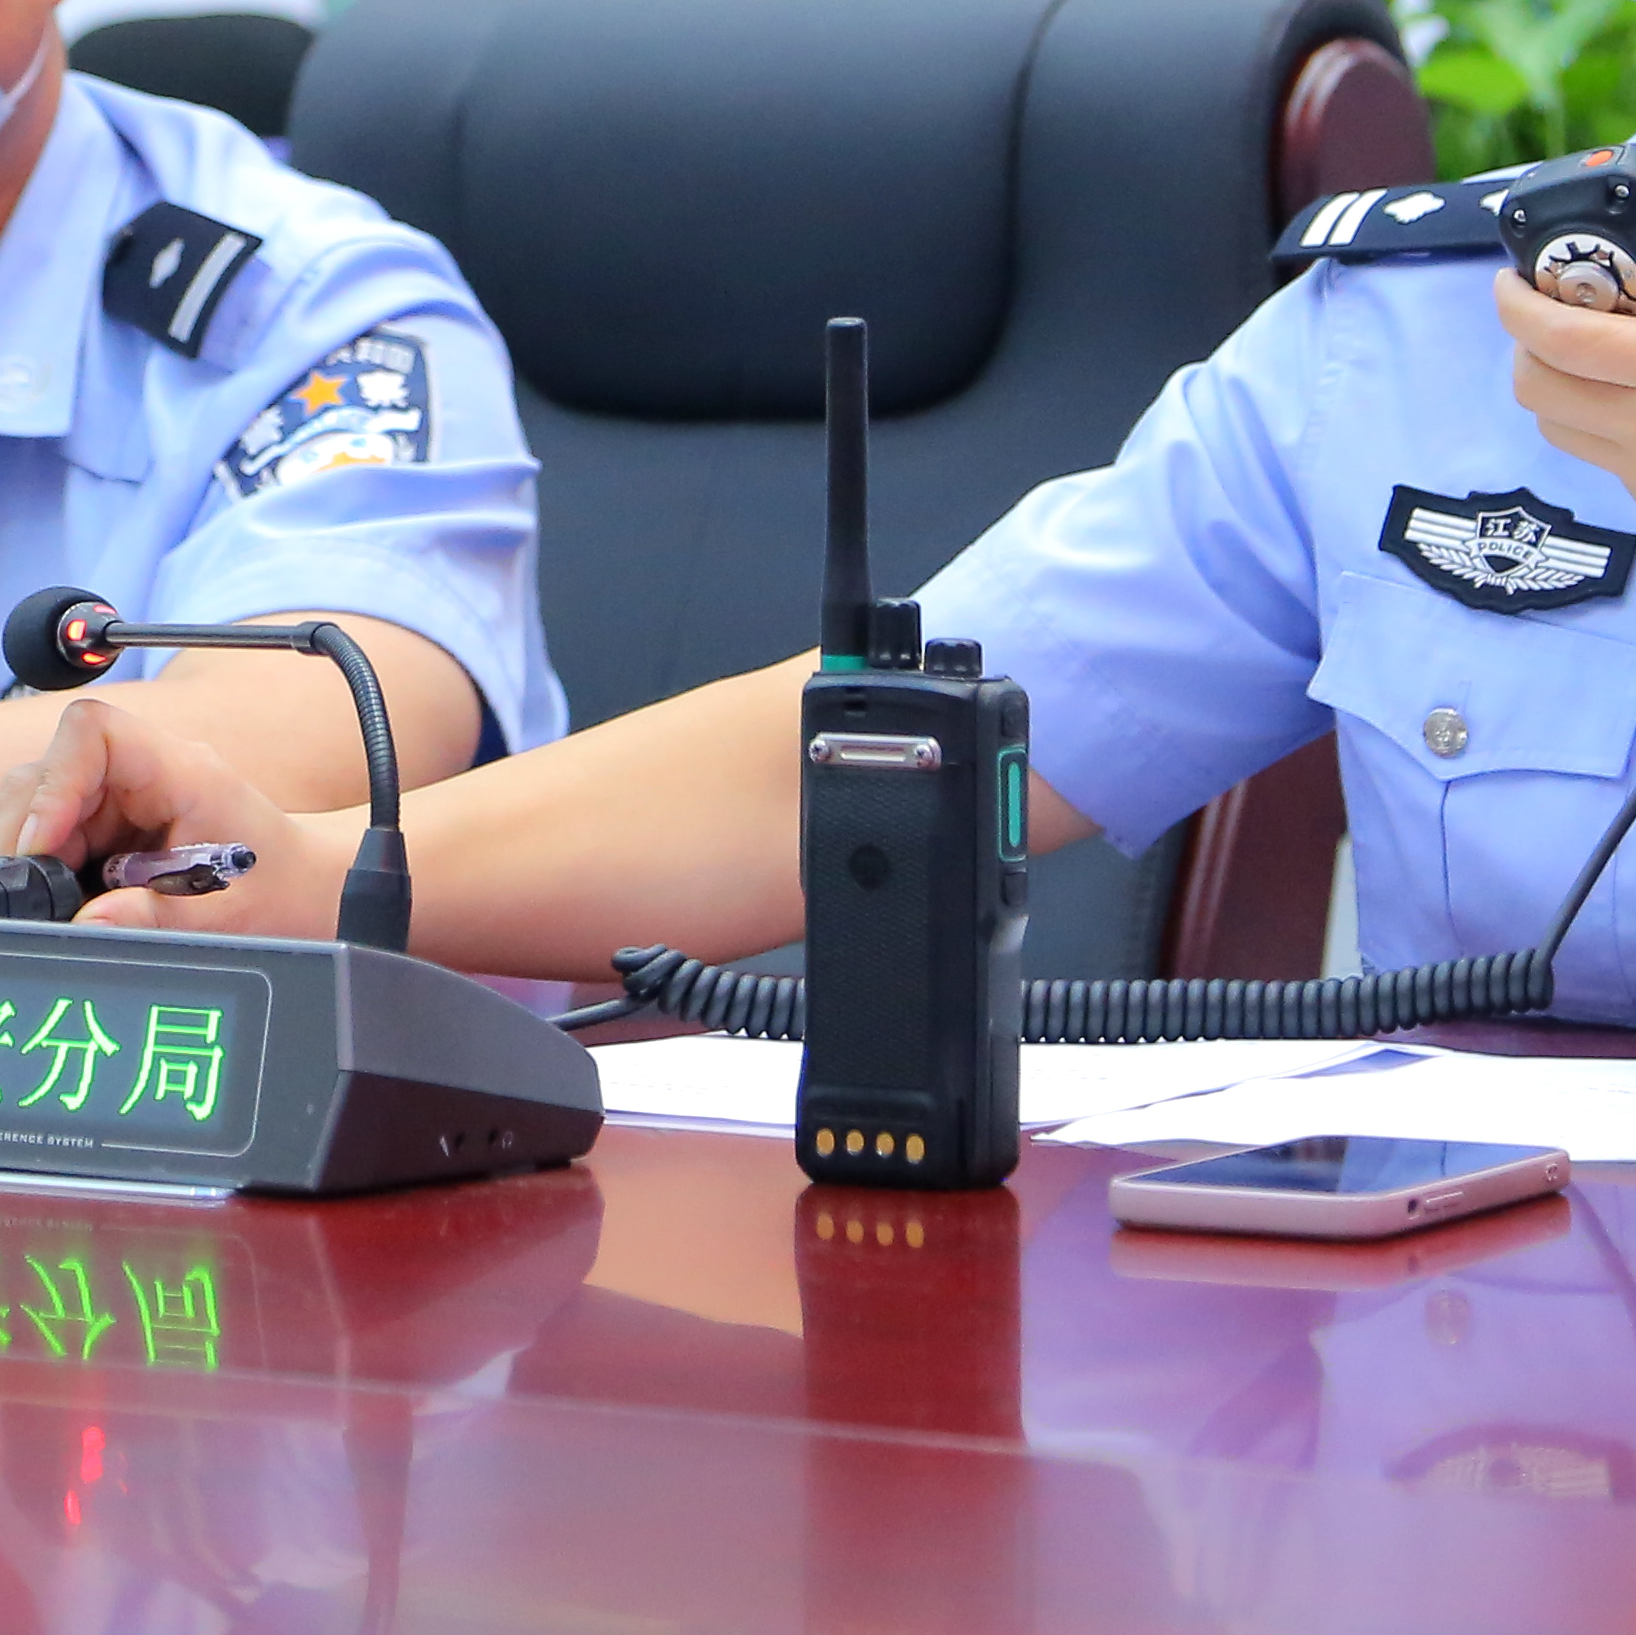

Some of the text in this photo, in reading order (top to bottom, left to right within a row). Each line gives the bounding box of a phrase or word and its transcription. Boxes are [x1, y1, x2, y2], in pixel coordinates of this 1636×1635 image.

[1485, 516, 1540, 544] 江苏
[1477, 541, 1533, 560] POLICE
[47, 1134, 94, 1148] SYSTEM
